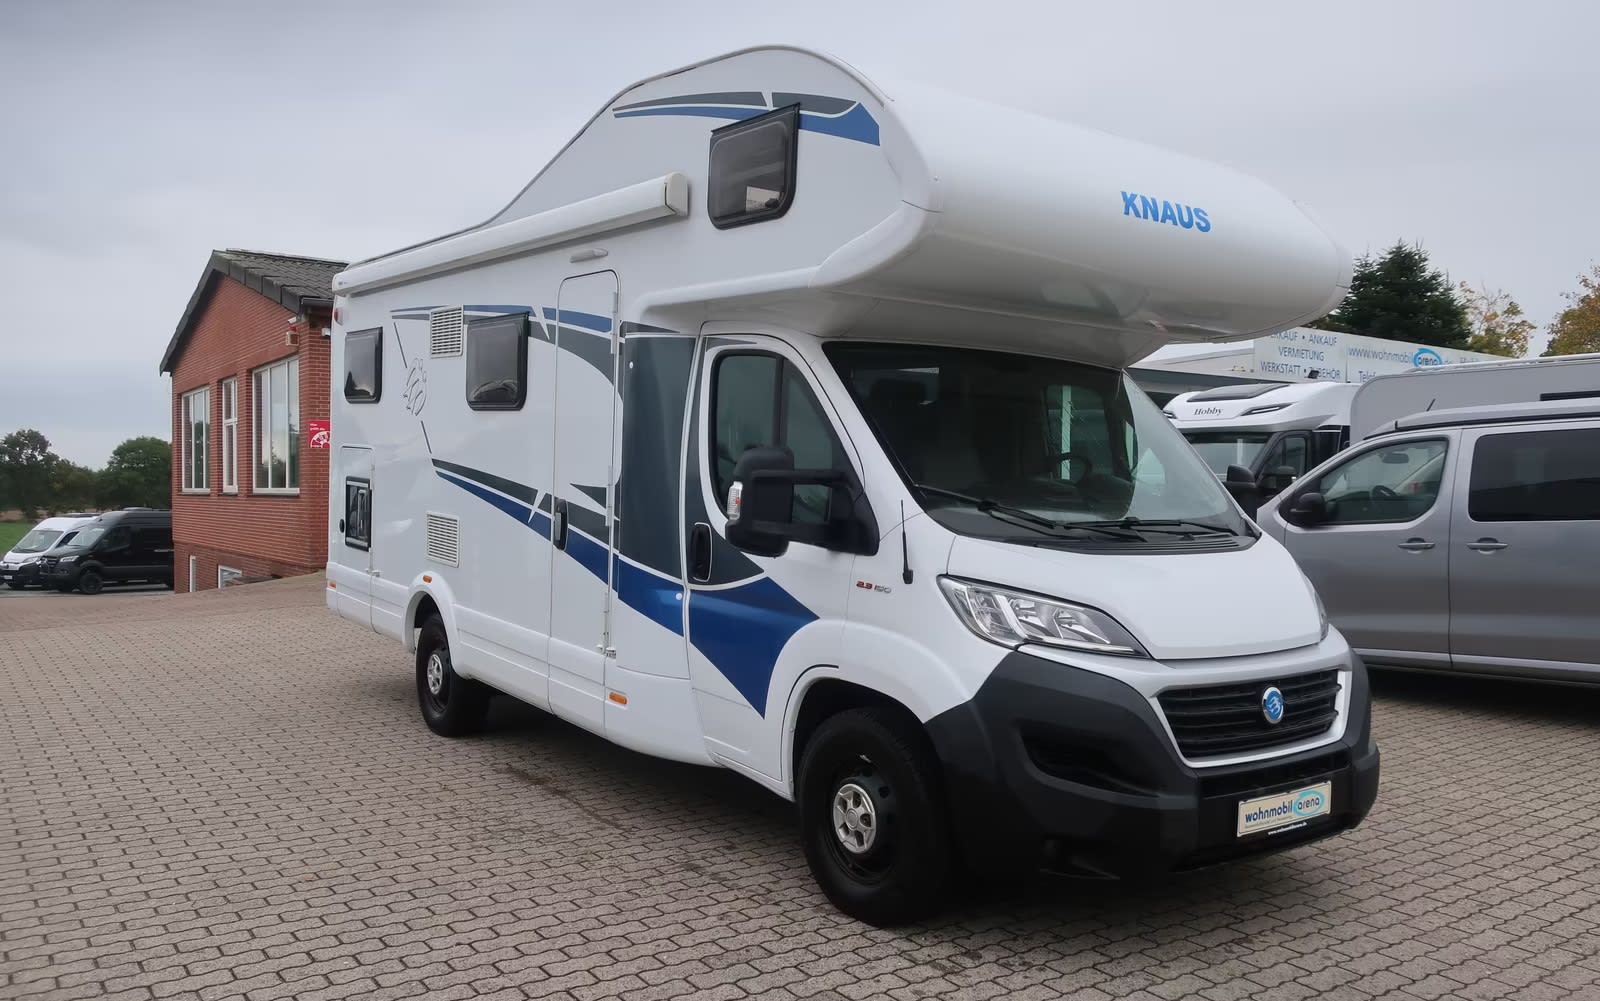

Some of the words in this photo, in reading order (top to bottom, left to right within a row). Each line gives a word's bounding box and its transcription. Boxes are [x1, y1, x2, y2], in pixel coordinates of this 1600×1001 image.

[1120, 191, 1211, 232] KNAUS
[1309, 334, 1337, 346] ANKAUF
[1279, 346, 1325, 361] VERMIETUNG
[1261, 361, 1301, 376] WERKSTATT
[1308, 366, 1341, 379] BEHÖR
[1194, 407, 1223, 416] Hobby
[1245, 800, 1293, 823] wohnmobil
[1297, 797, 1320, 810] arena
